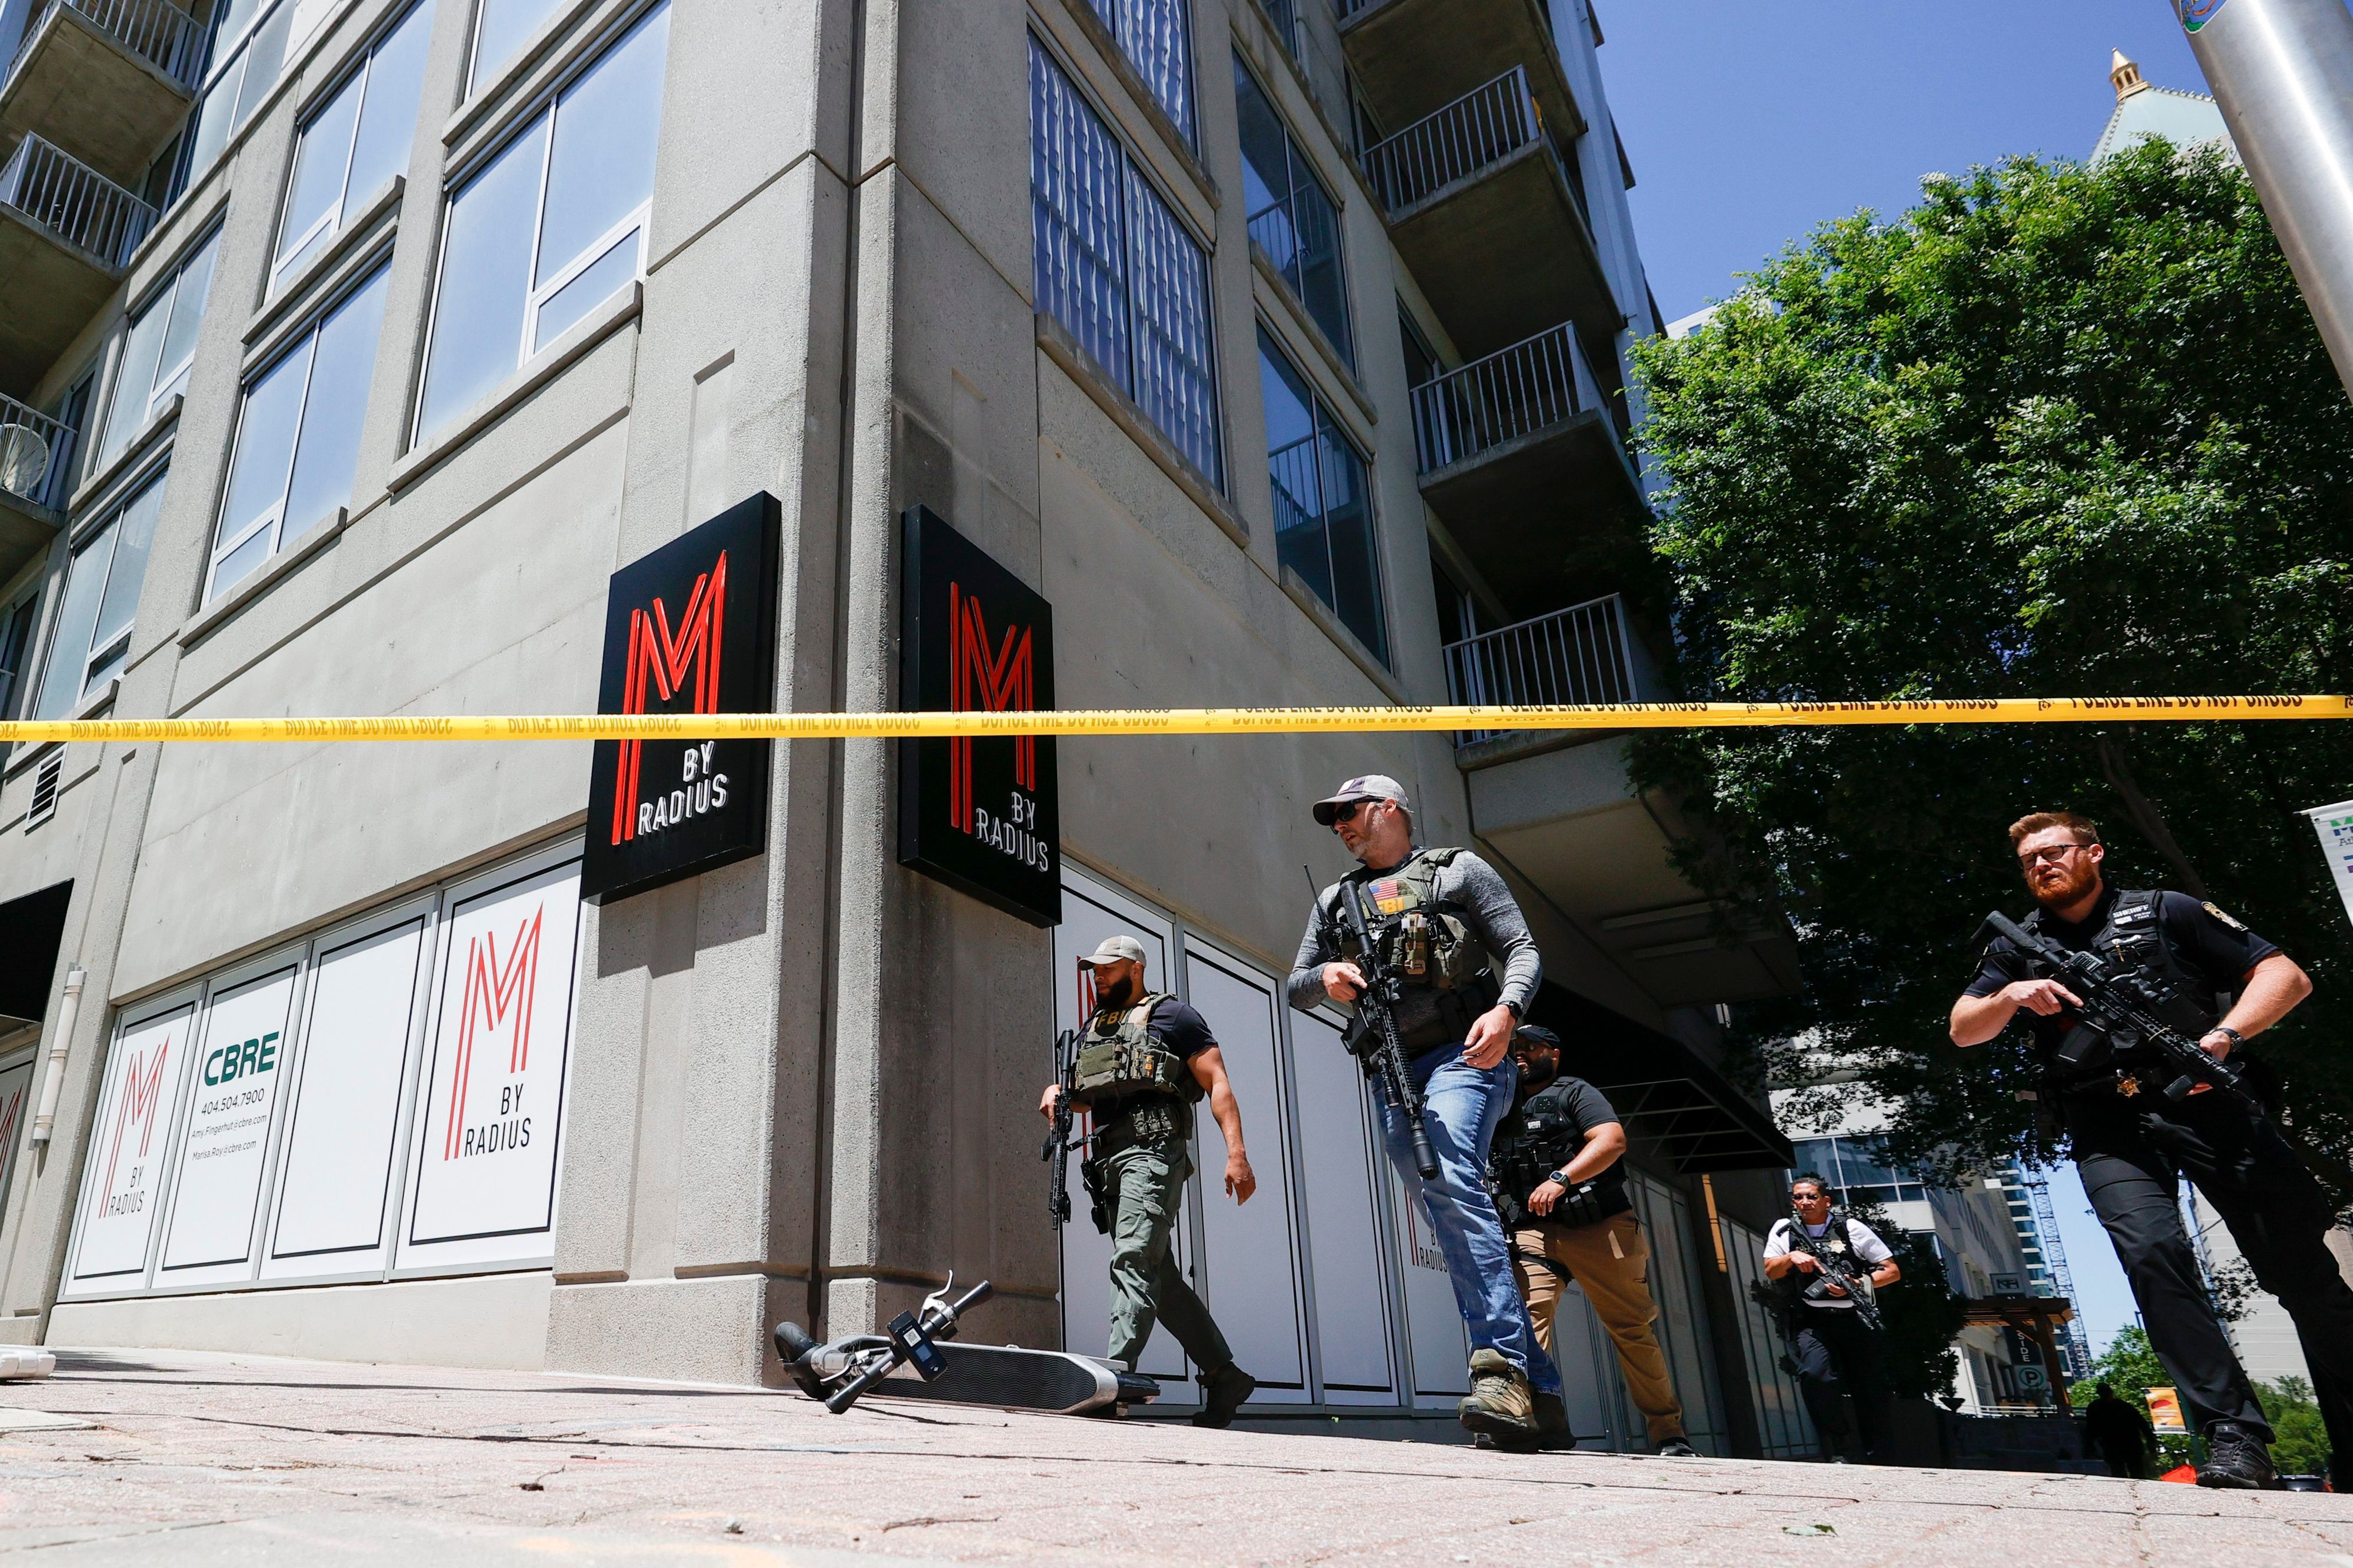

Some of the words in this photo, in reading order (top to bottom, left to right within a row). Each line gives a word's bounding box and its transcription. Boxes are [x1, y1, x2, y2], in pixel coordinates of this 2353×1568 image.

[683, 740, 715, 782] BY
[638, 773, 729, 836] RADIUS
[1011, 791, 1035, 830] BY
[975, 807, 1048, 872] RADIUS
[2112, 903, 2149, 918] SHERIFF
[444, 899, 544, 1161] M
[1096, 1009, 1126, 1028] FBI
[204, 1030, 280, 1087] CBRE
[1145, 1056, 1153, 1077] FBI
[201, 1087, 265, 1116] 404.504.7900
[501, 1083, 524, 1116] BY
[98, 1030, 171, 1219] M
[191, 1113, 268, 1139] Amy.Fingerhut@cbre.com
[464, 1117, 532, 1157] RADIUS
[192, 1139, 256, 1161] Marisa.Roy@cbre.com
[129, 1165, 145, 1188] BY
[108, 1190, 145, 1217] RADIUS
[1419, 1246, 1448, 1273] RADIUS
